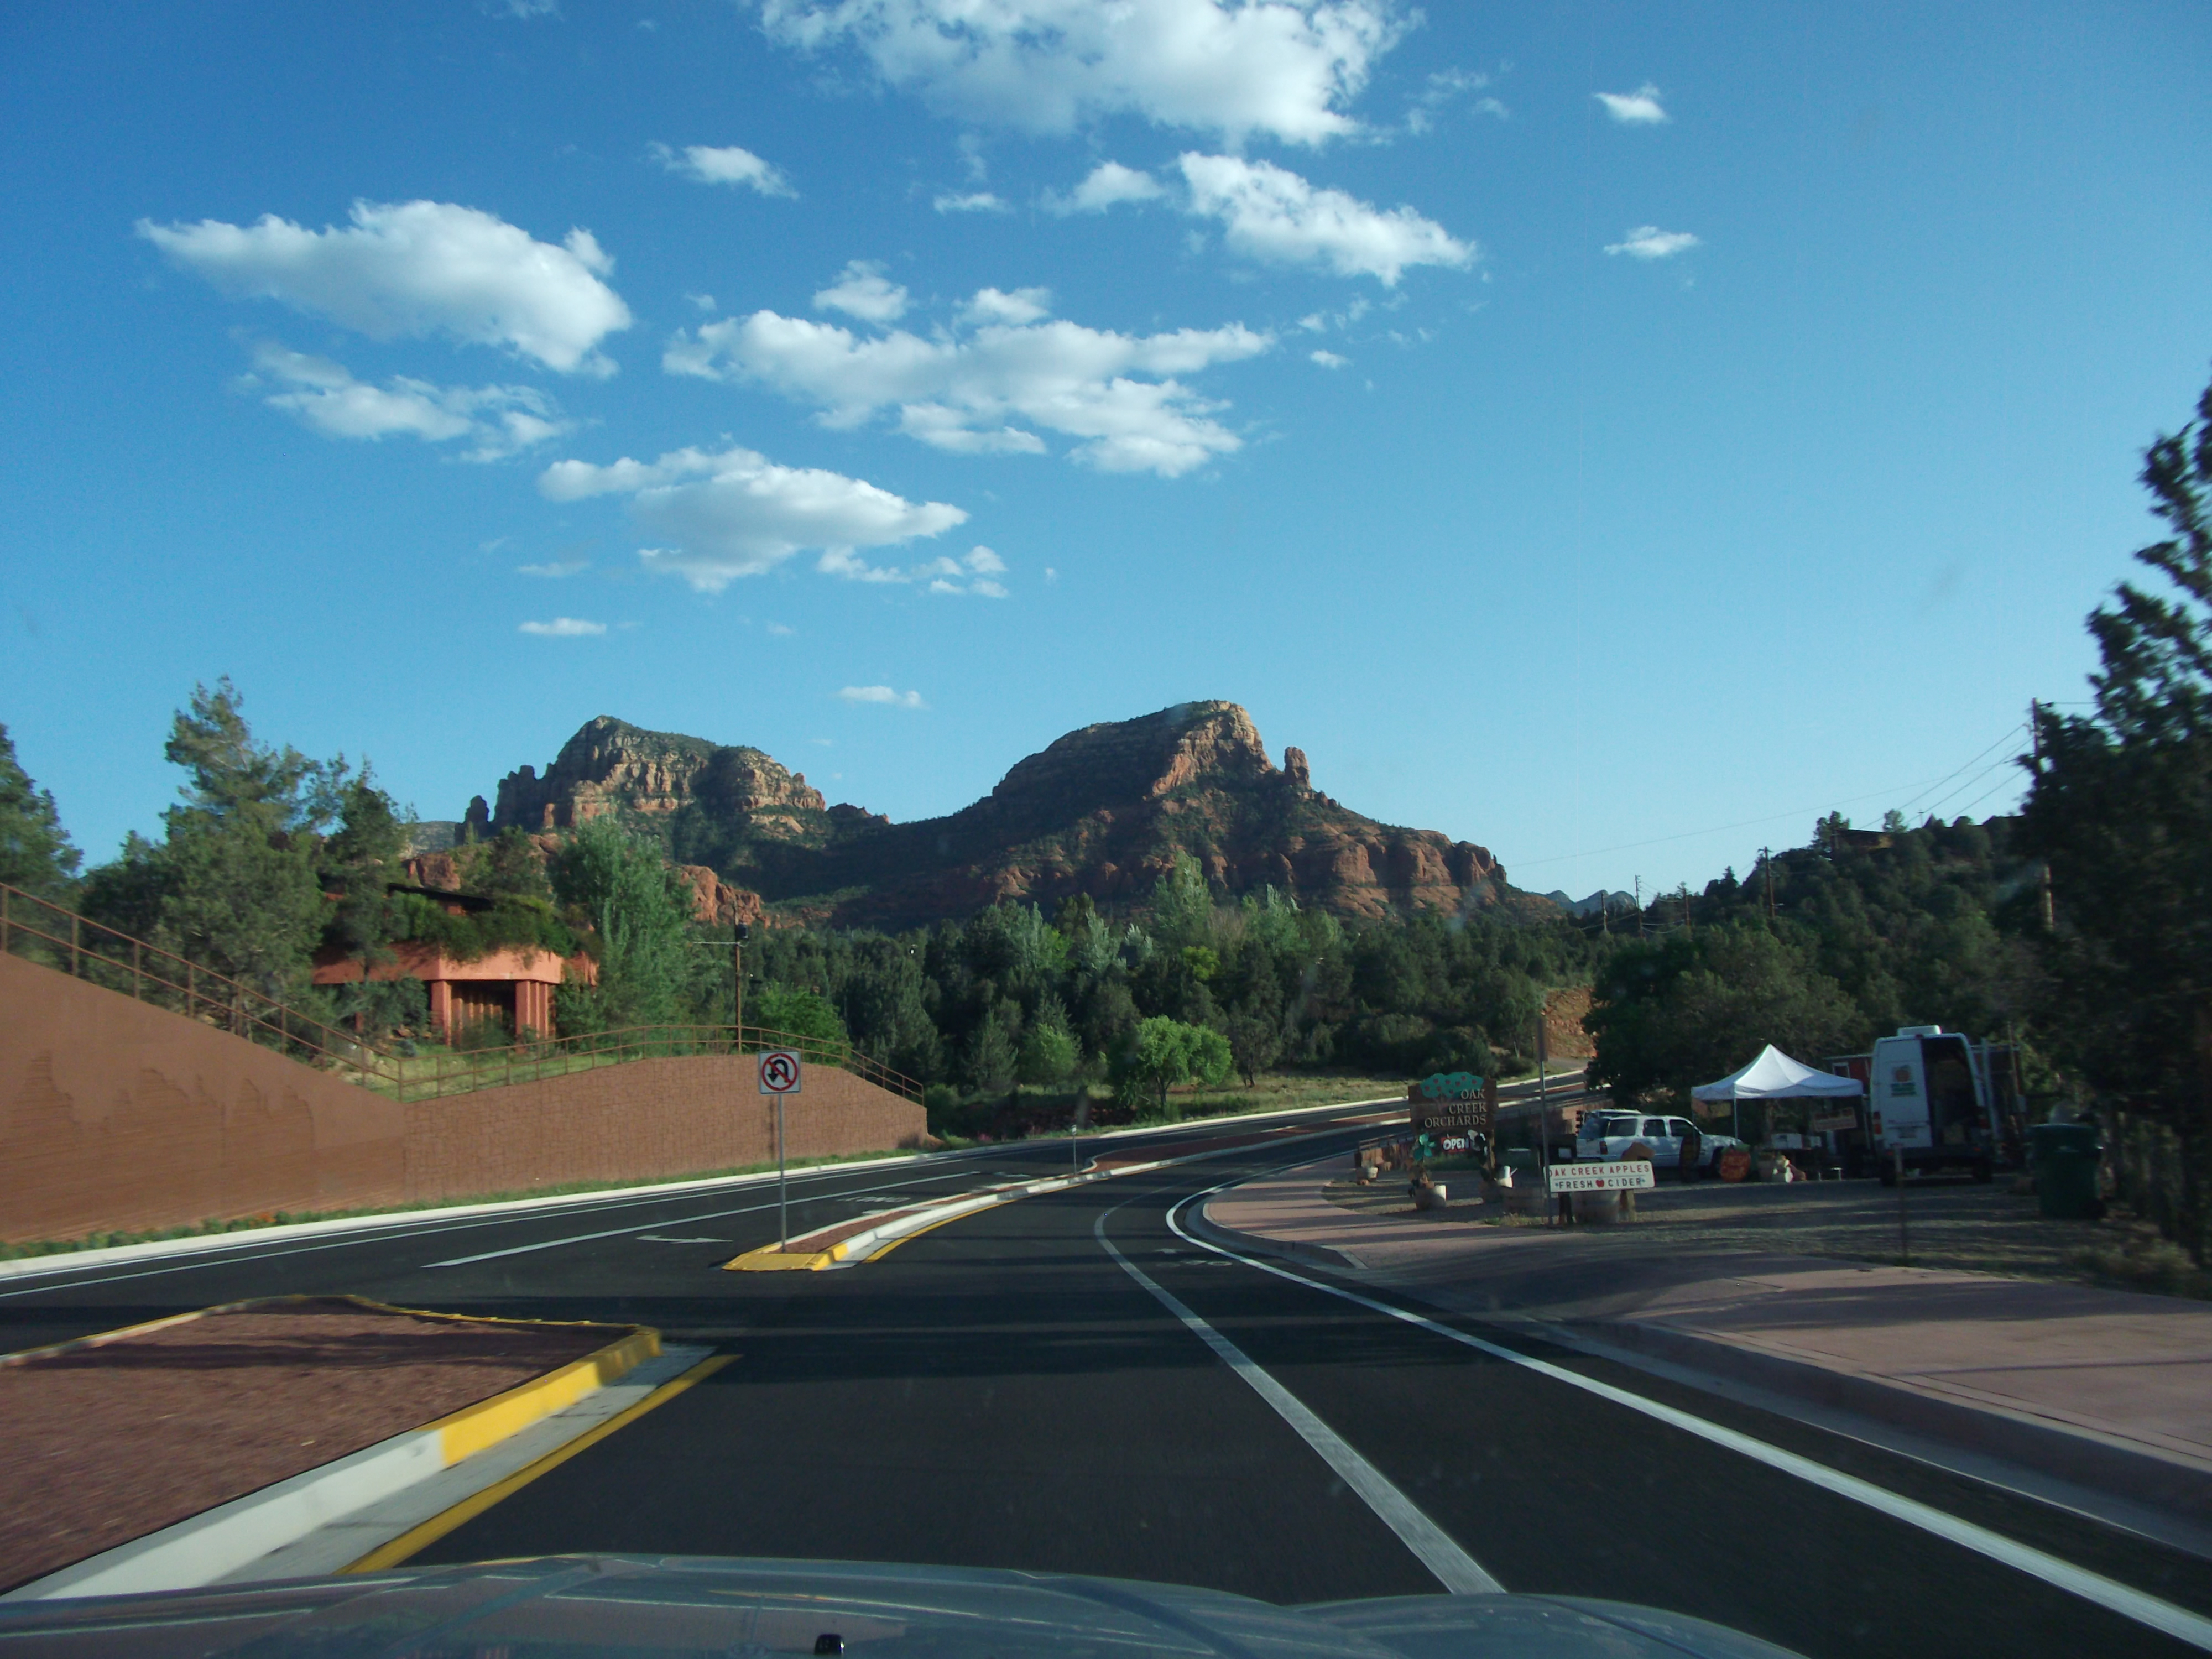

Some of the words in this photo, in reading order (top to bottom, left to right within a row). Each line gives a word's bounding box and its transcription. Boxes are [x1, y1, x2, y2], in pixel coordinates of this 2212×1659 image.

[1461, 1089, 1484, 1099] OAK
[1449, 1103, 1486, 1114] CREEK
[1425, 1115, 1486, 1127] ORCHARDS
[1443, 1138, 1469, 1150] OPEN
[1571, 1166, 1604, 1176] CREEK
[1609, 1165, 1650, 1173] APPLES
[1558, 1180, 1593, 1189] FRESH
[1608, 1178, 1641, 1187] CIDER
